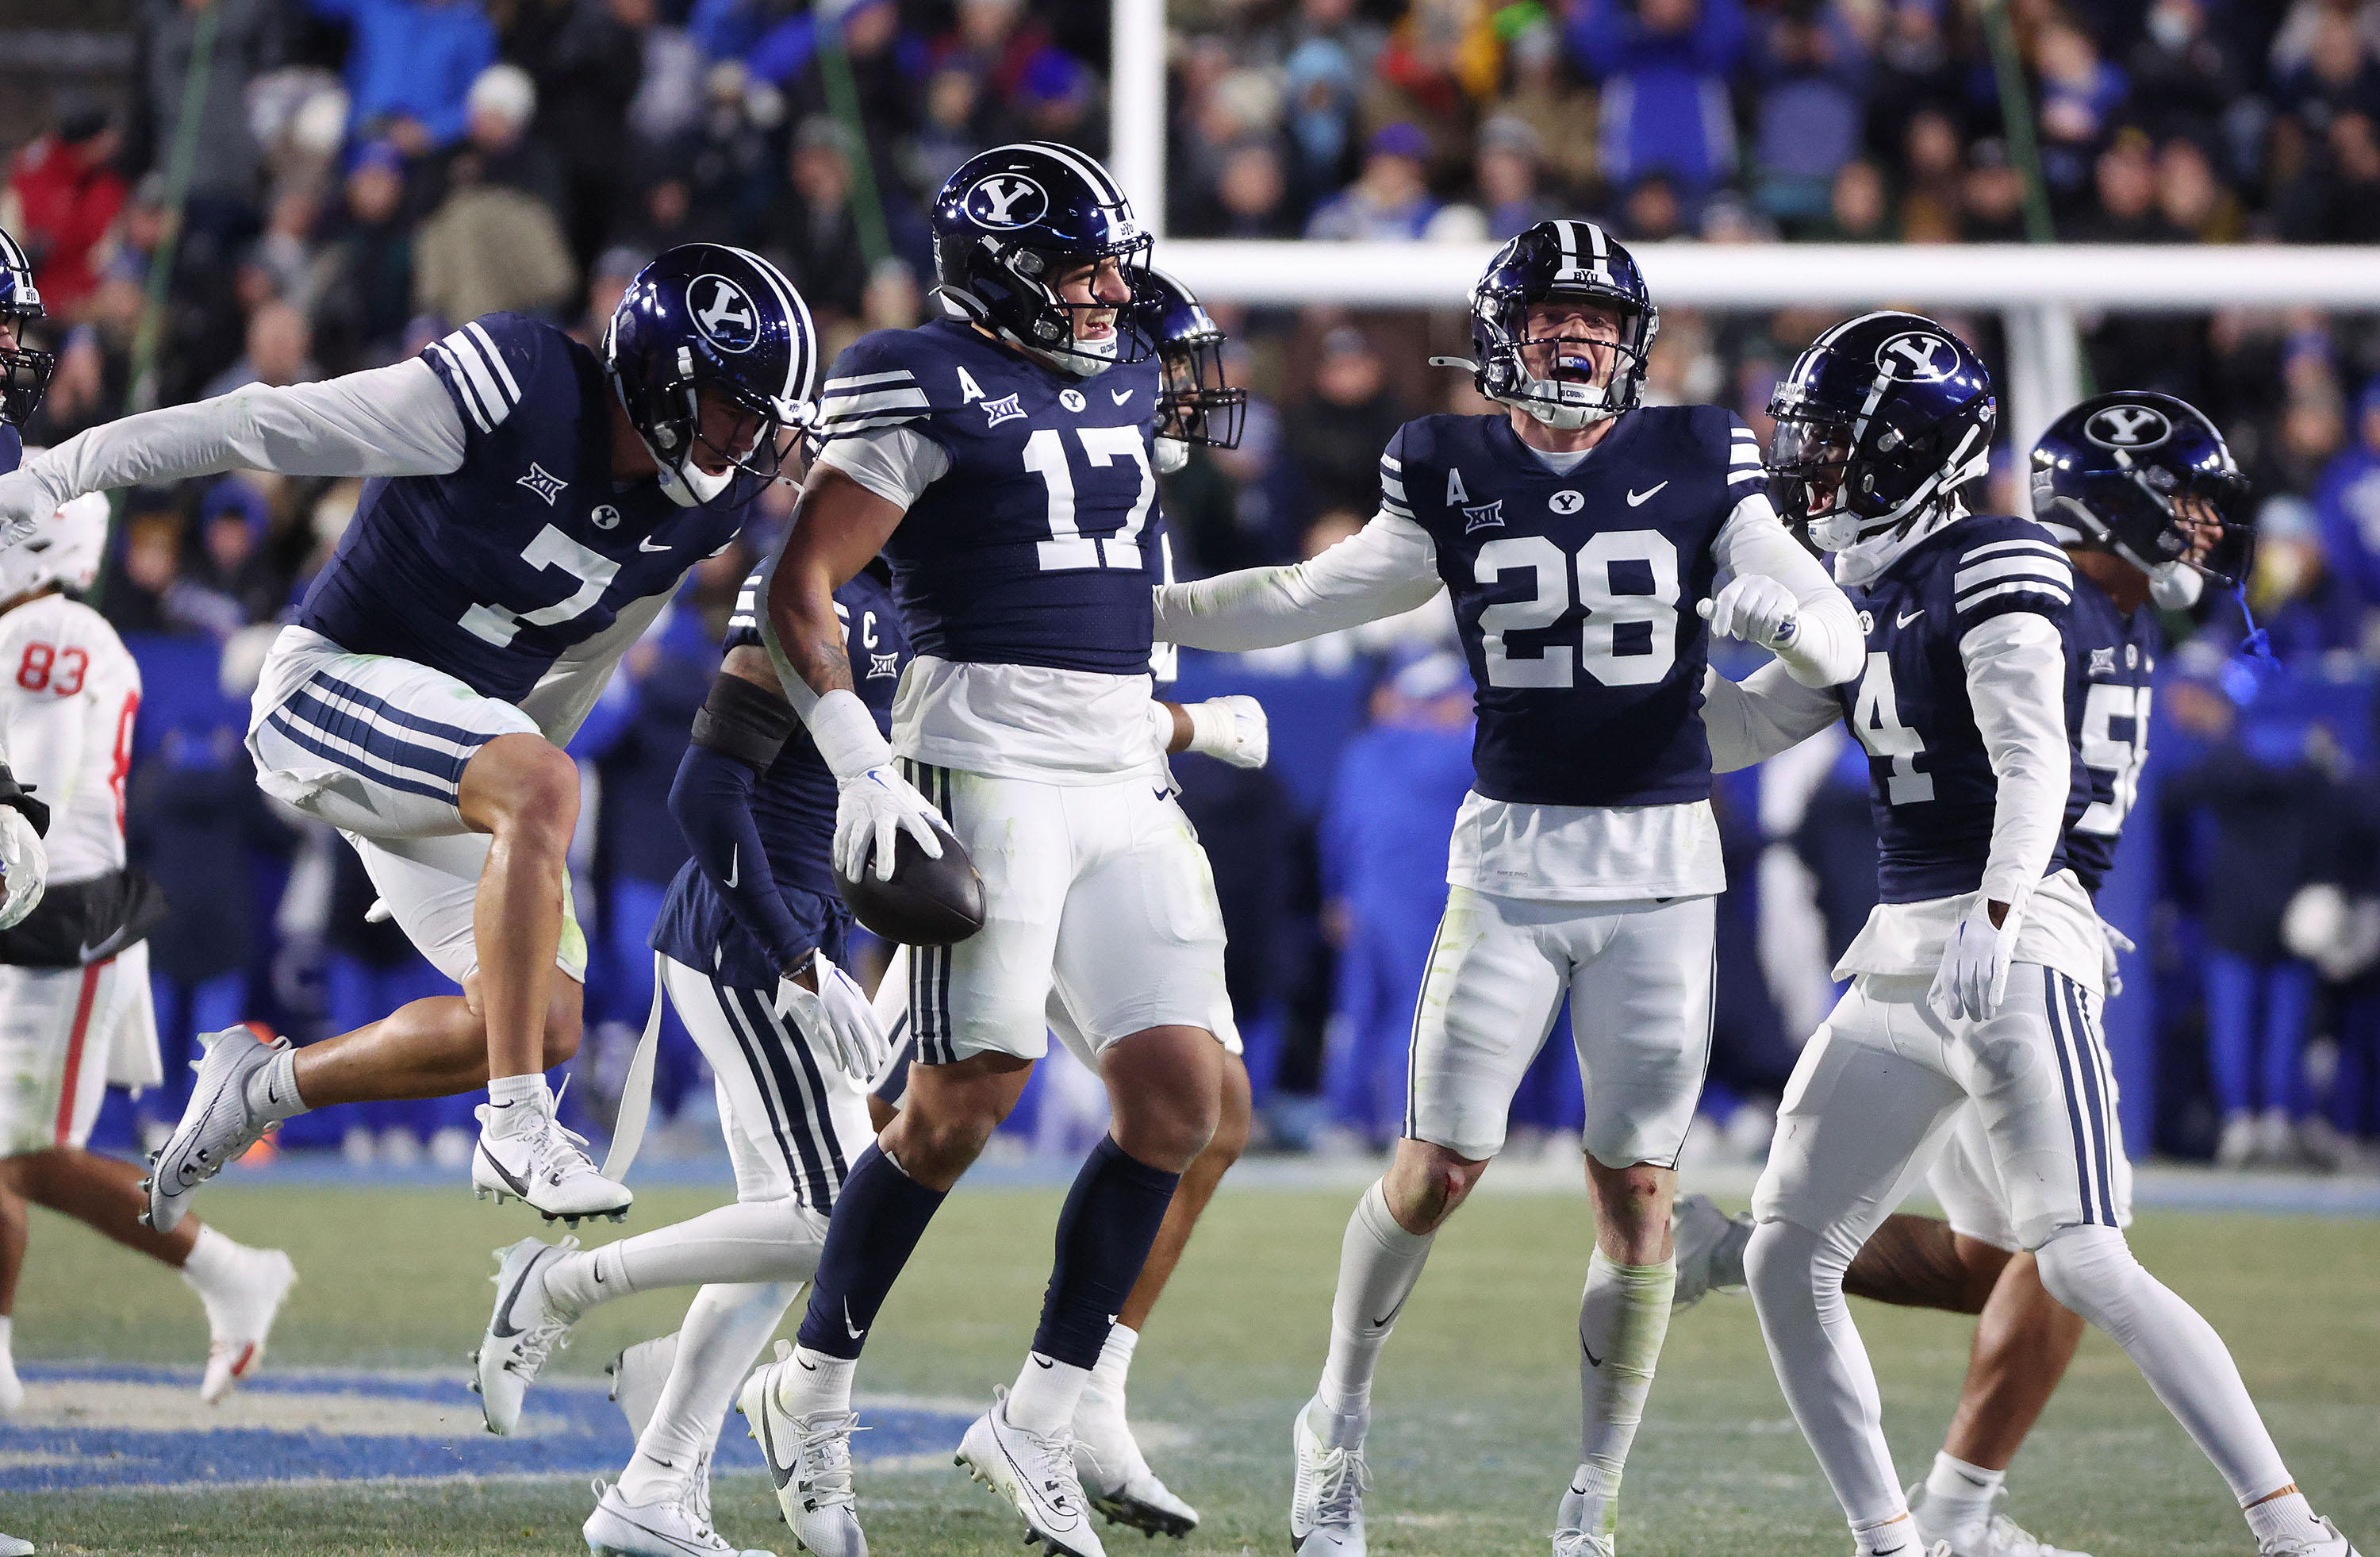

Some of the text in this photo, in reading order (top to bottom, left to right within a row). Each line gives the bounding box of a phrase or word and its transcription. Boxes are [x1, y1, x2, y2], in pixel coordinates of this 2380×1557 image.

[979, 179, 1035, 221] Y
[1573, 270, 1599, 283] BYU
[697, 280, 752, 333] Y
[1887, 336, 1942, 375] Y
[956, 366, 987, 405] A
[983, 394, 1024, 425] XII
[2100, 409, 2158, 444] Y
[1022, 424, 1156, 571] 17
[1446, 467, 1469, 506] A
[1464, 502, 1503, 532] XII
[457, 522, 622, 648] 7
[1474, 529, 1681, 688] 28
[863, 611, 878, 649] C
[16, 640, 89, 696] 83
[869, 654, 897, 677] XII
[1853, 652, 1935, 805] 4
